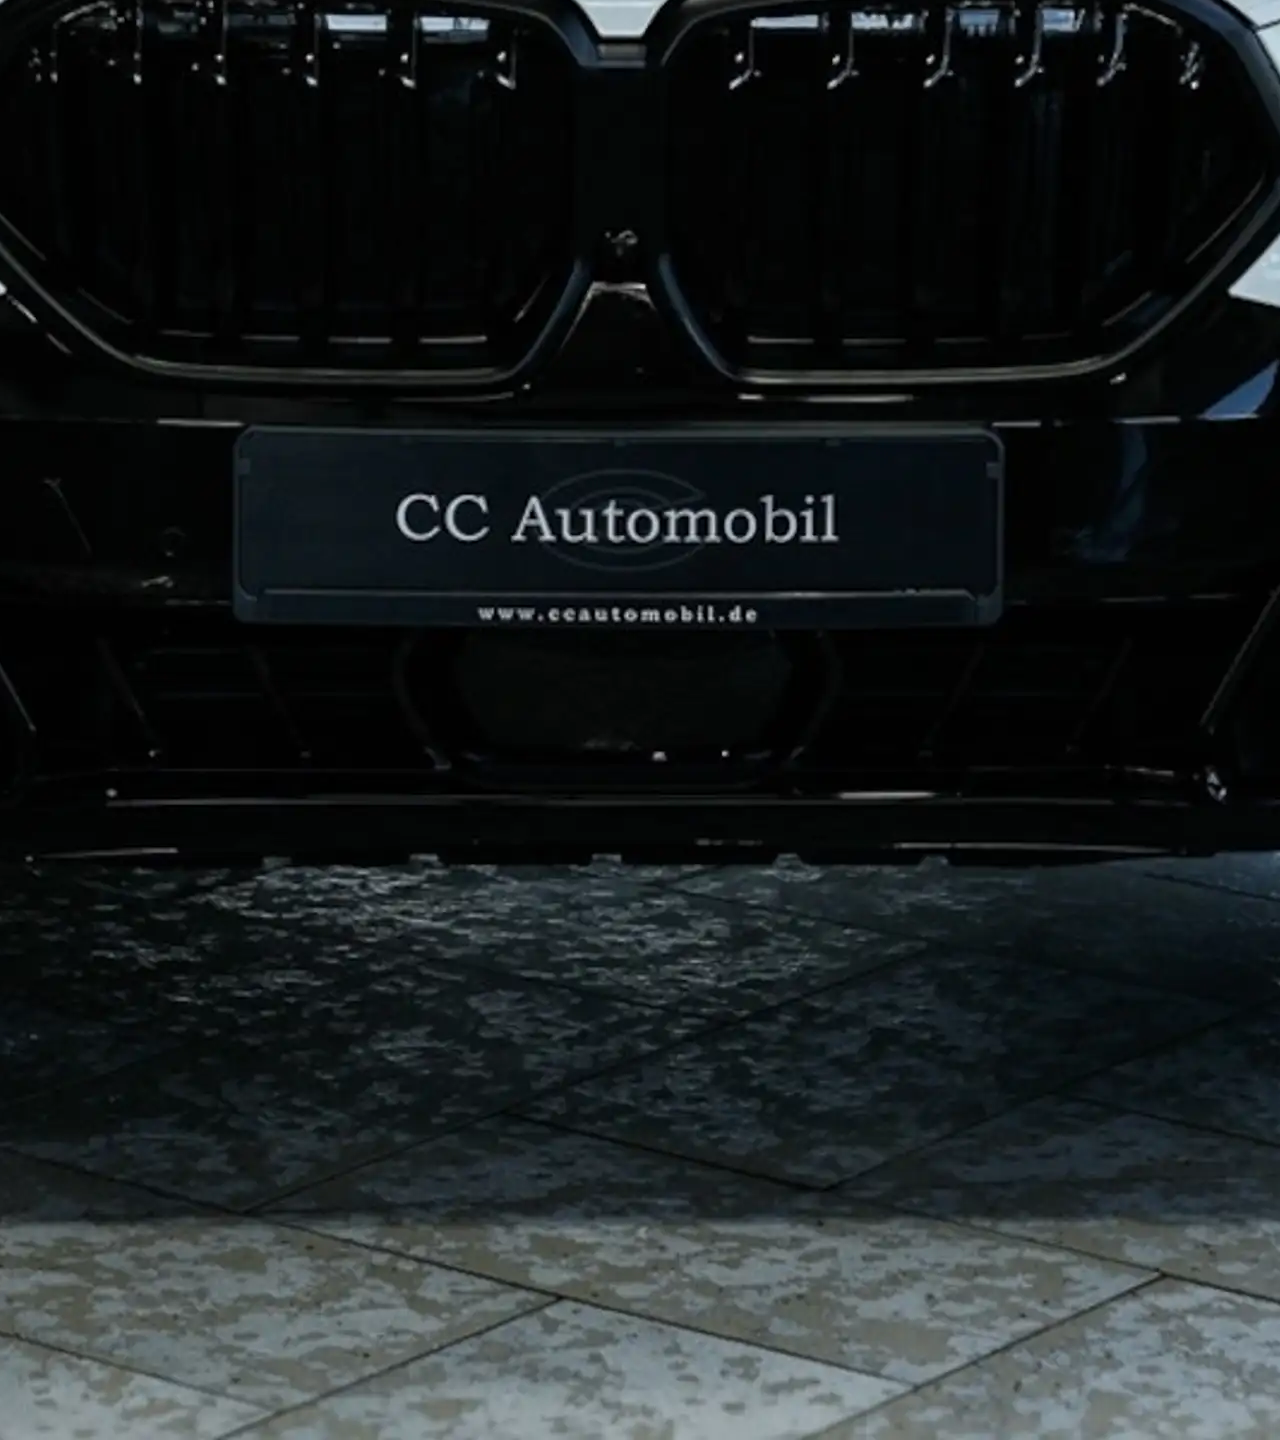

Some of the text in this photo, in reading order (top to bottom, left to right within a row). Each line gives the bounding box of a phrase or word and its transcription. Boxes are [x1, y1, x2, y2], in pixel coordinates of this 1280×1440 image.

[396, 493, 838, 543] CC Automobil
[477, 605, 758, 623] www.ccautomobil.de
